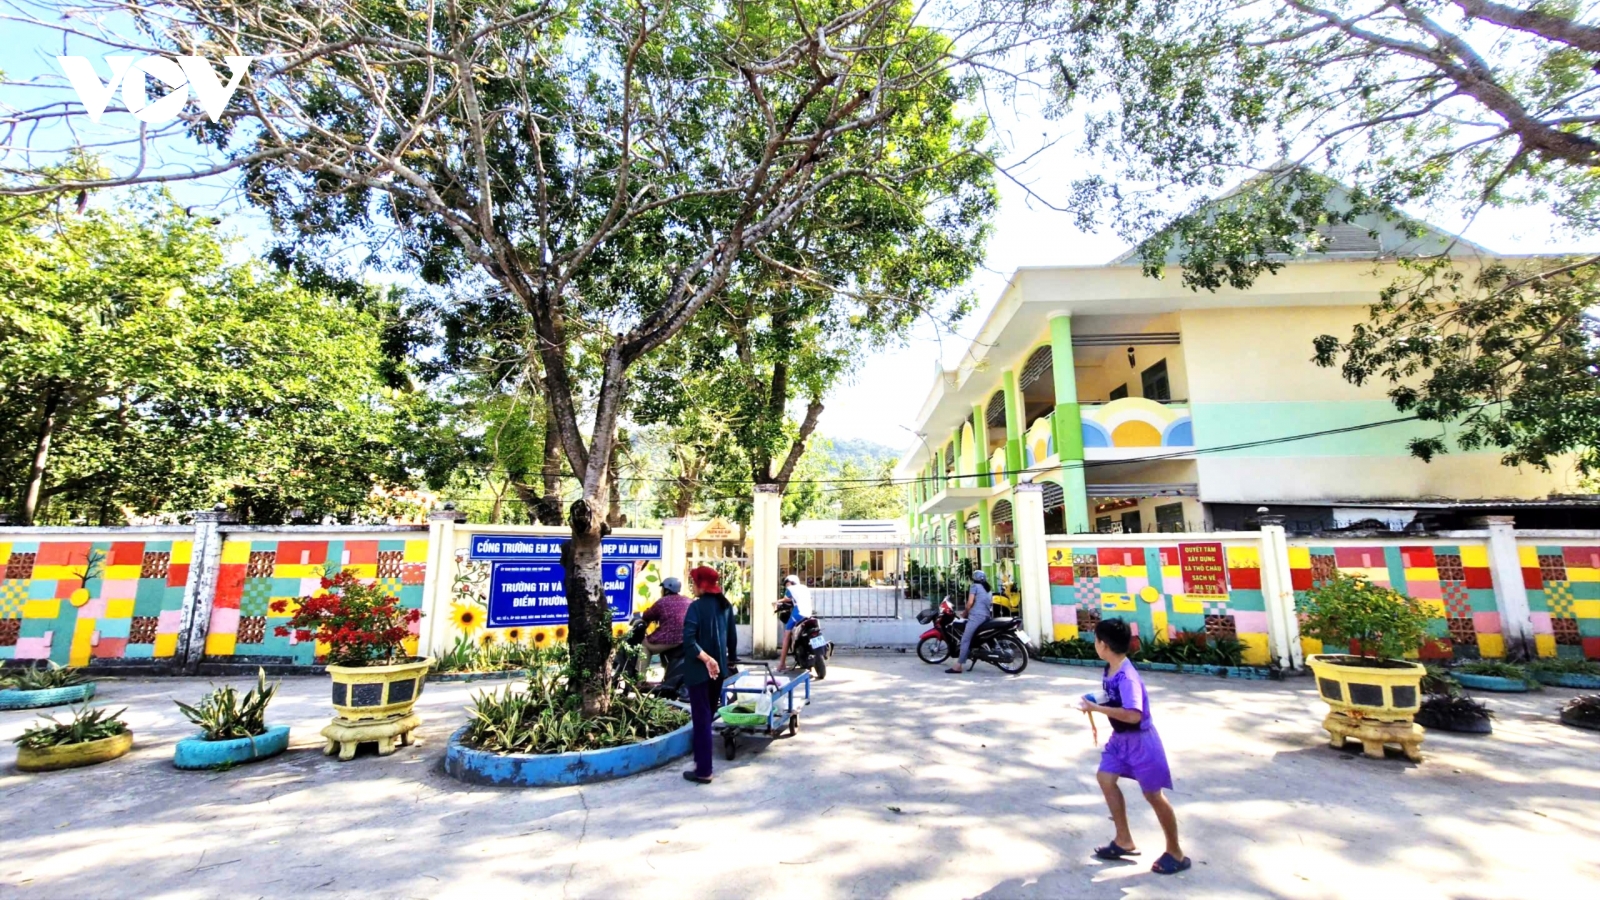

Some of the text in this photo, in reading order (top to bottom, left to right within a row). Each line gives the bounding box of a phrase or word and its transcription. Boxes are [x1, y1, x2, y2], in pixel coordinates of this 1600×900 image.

[477, 539, 500, 553] CỔNG
[502, 541, 534, 553] TRƯỜNG
[535, 543, 548, 553] EM
[603, 544, 618, 556] ĐẸP
[618, 543, 627, 554] VÀ
[629, 544, 639, 554] AN
[640, 543, 658, 554] TOÀN
[501, 580, 625, 592] TRƯỜNG TH VÀ CHÂU
[513, 594, 569, 607] ĐIỂM TRƯỜN
